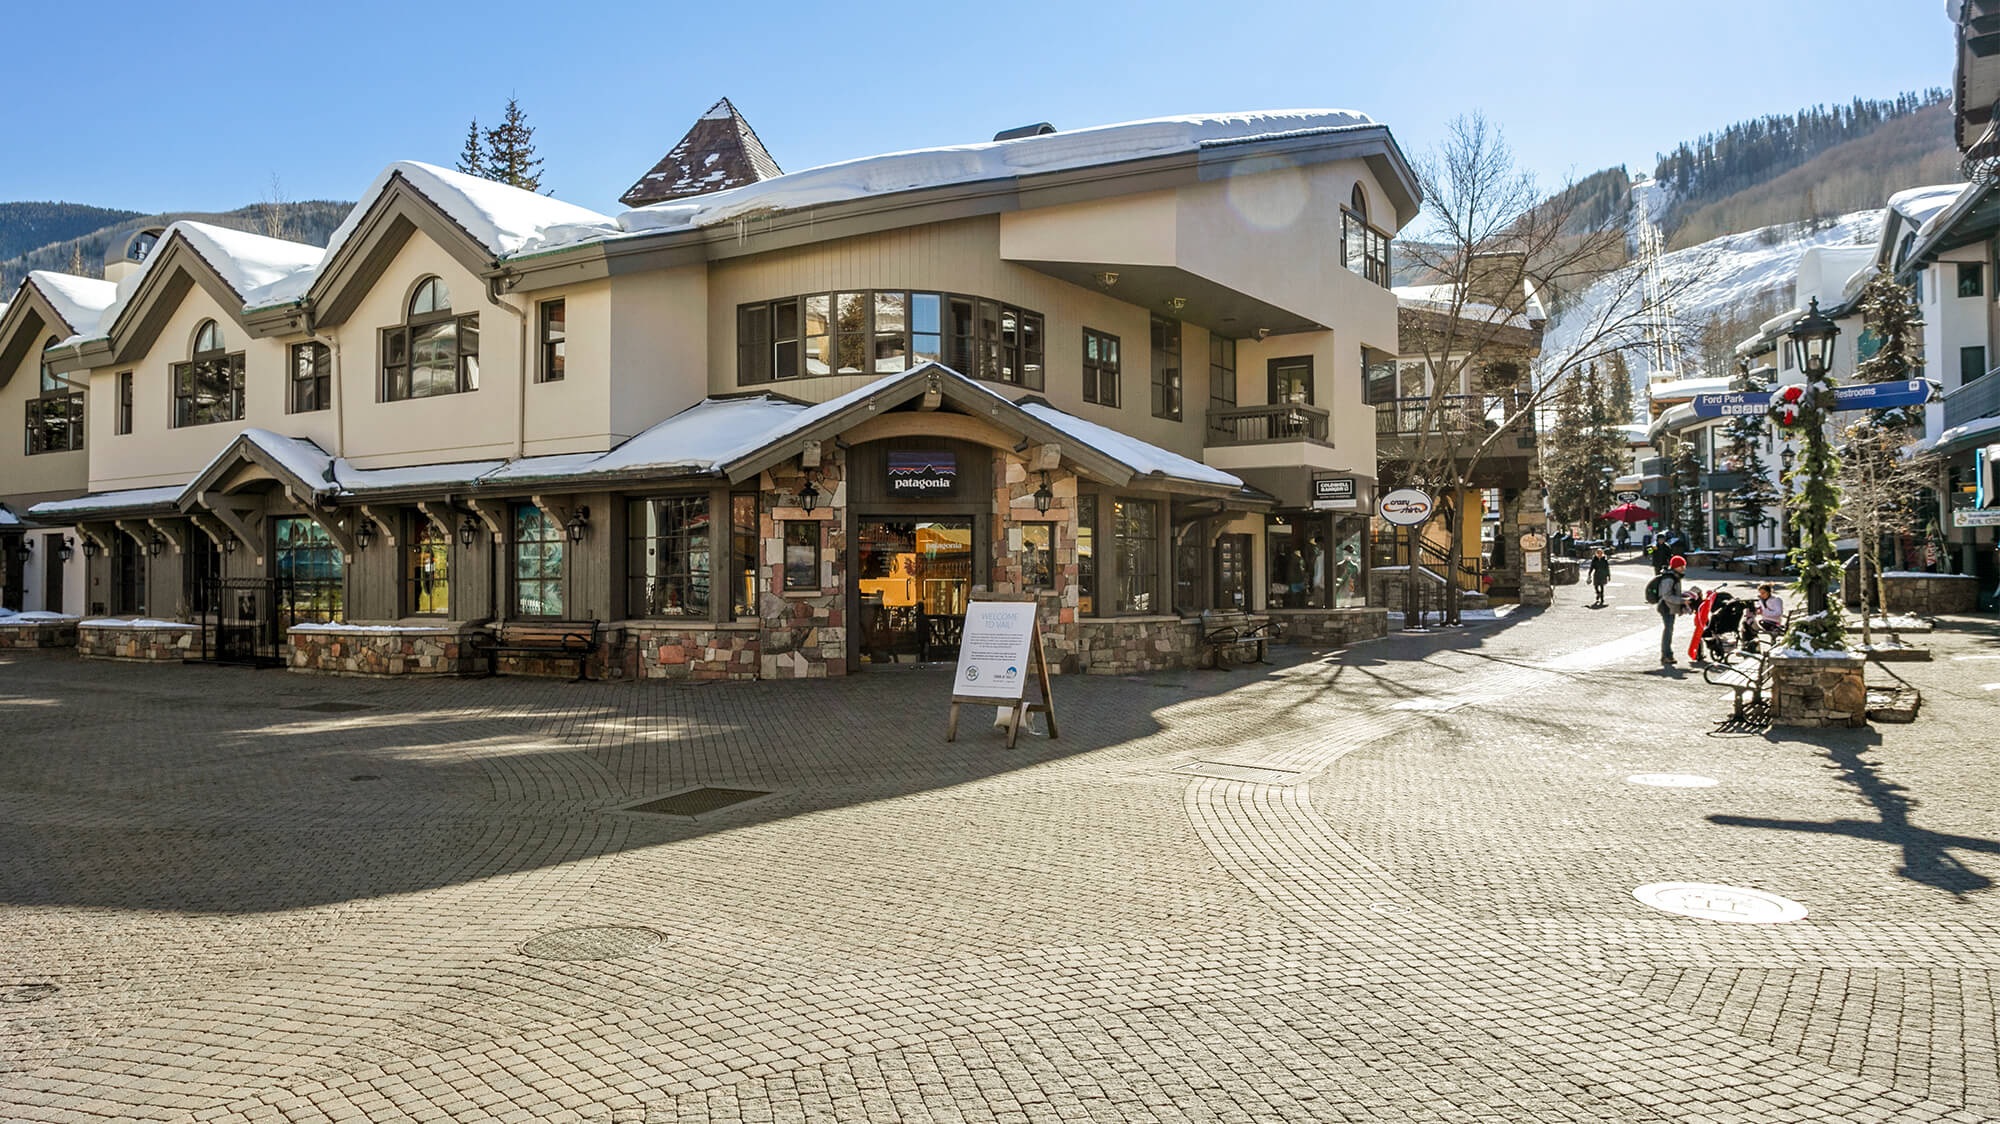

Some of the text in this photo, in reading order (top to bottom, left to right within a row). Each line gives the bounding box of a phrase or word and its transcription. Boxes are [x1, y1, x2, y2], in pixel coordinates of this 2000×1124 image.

[1834, 388, 1876, 399] Restrooms
[1703, 394, 1744, 404] Ford Park
[895, 478, 951, 489] patagonia
[926, 543, 962, 551] patagonia
[982, 612, 1018, 621] WELCOME
[985, 620, 994, 629] TO
